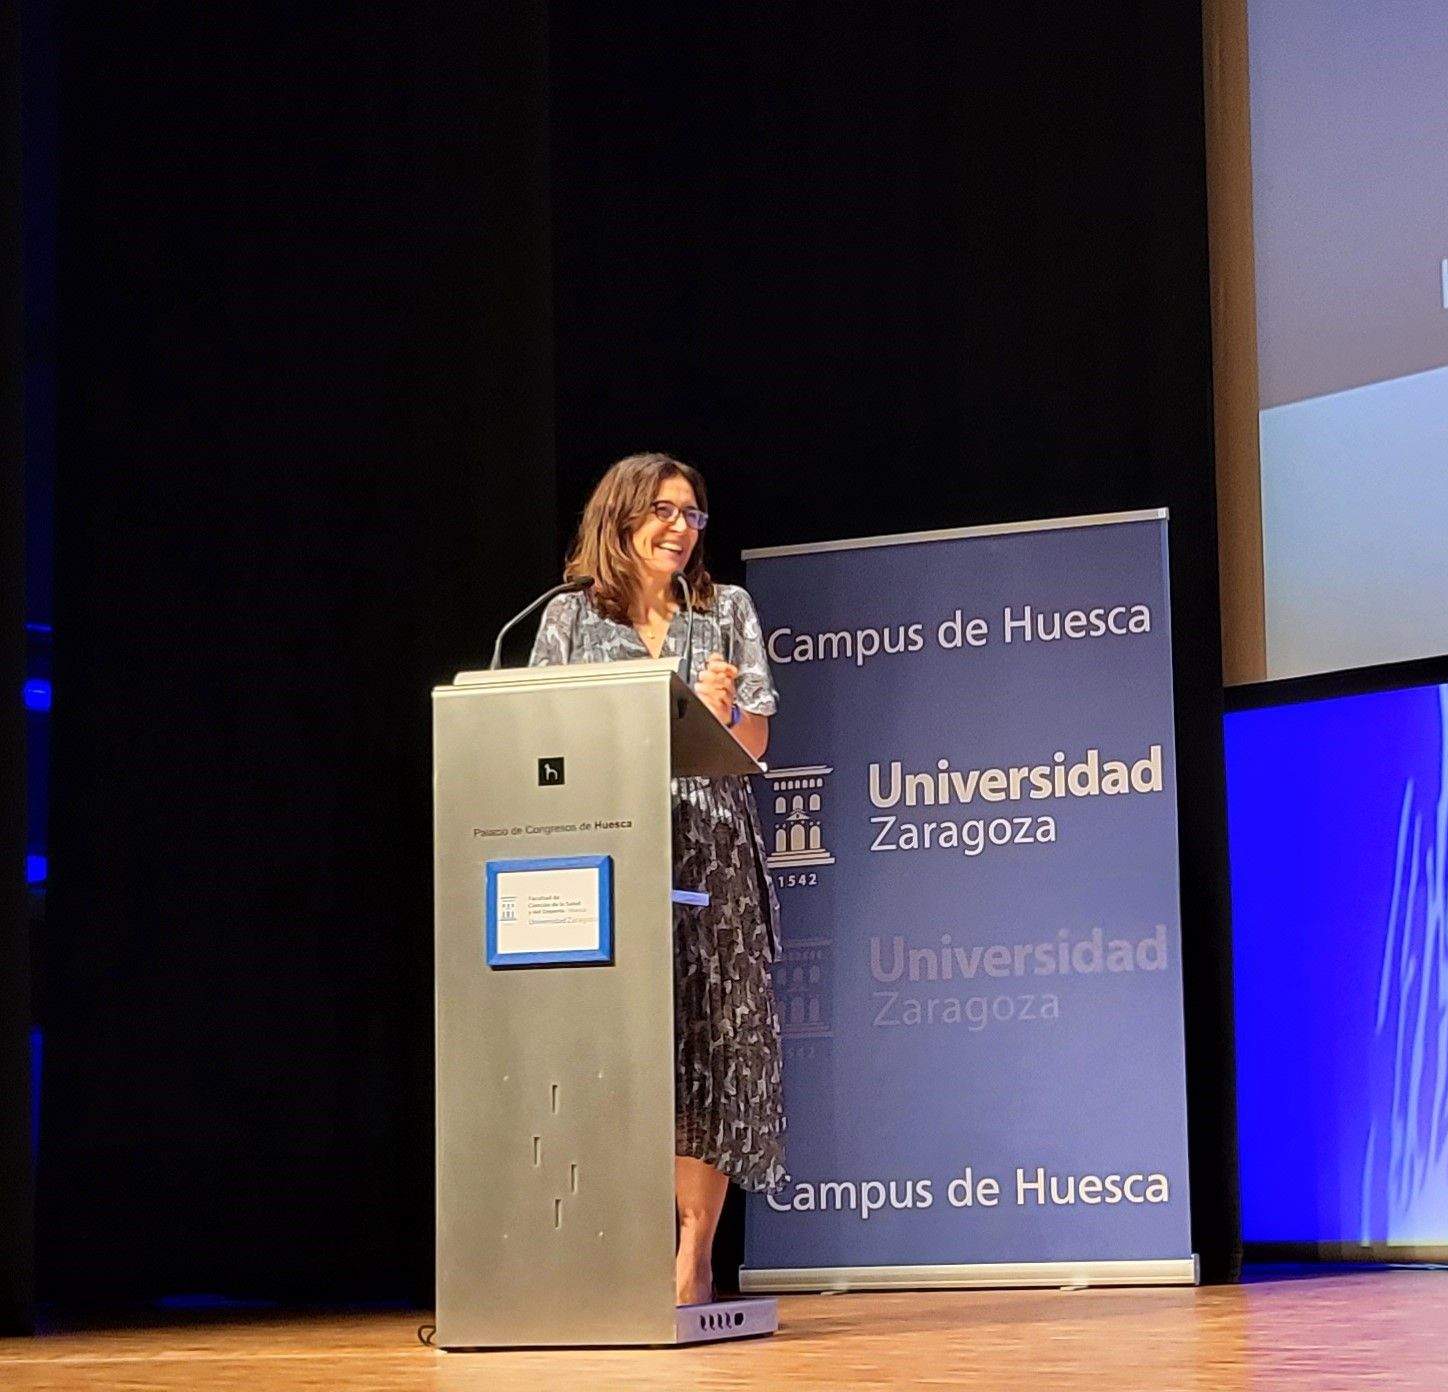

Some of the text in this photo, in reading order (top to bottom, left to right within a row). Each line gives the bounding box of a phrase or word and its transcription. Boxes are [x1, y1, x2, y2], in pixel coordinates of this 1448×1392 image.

[767, 603, 1151, 666] Campus de Huesca
[868, 745, 1163, 808] Universidad
[511, 826, 523, 836] de
[525, 824, 577, 835] Congresos
[579, 822, 592, 832] de
[594, 820, 632, 831] Huesca
[870, 815, 1057, 856] Zaragoza
[777, 873, 818, 888] 1542
[869, 924, 1168, 982] Universidad
[872, 991, 1061, 1032] Zaragoza
[946, 1167, 1000, 1207] de
[1015, 1167, 1170, 1206] Huesca
